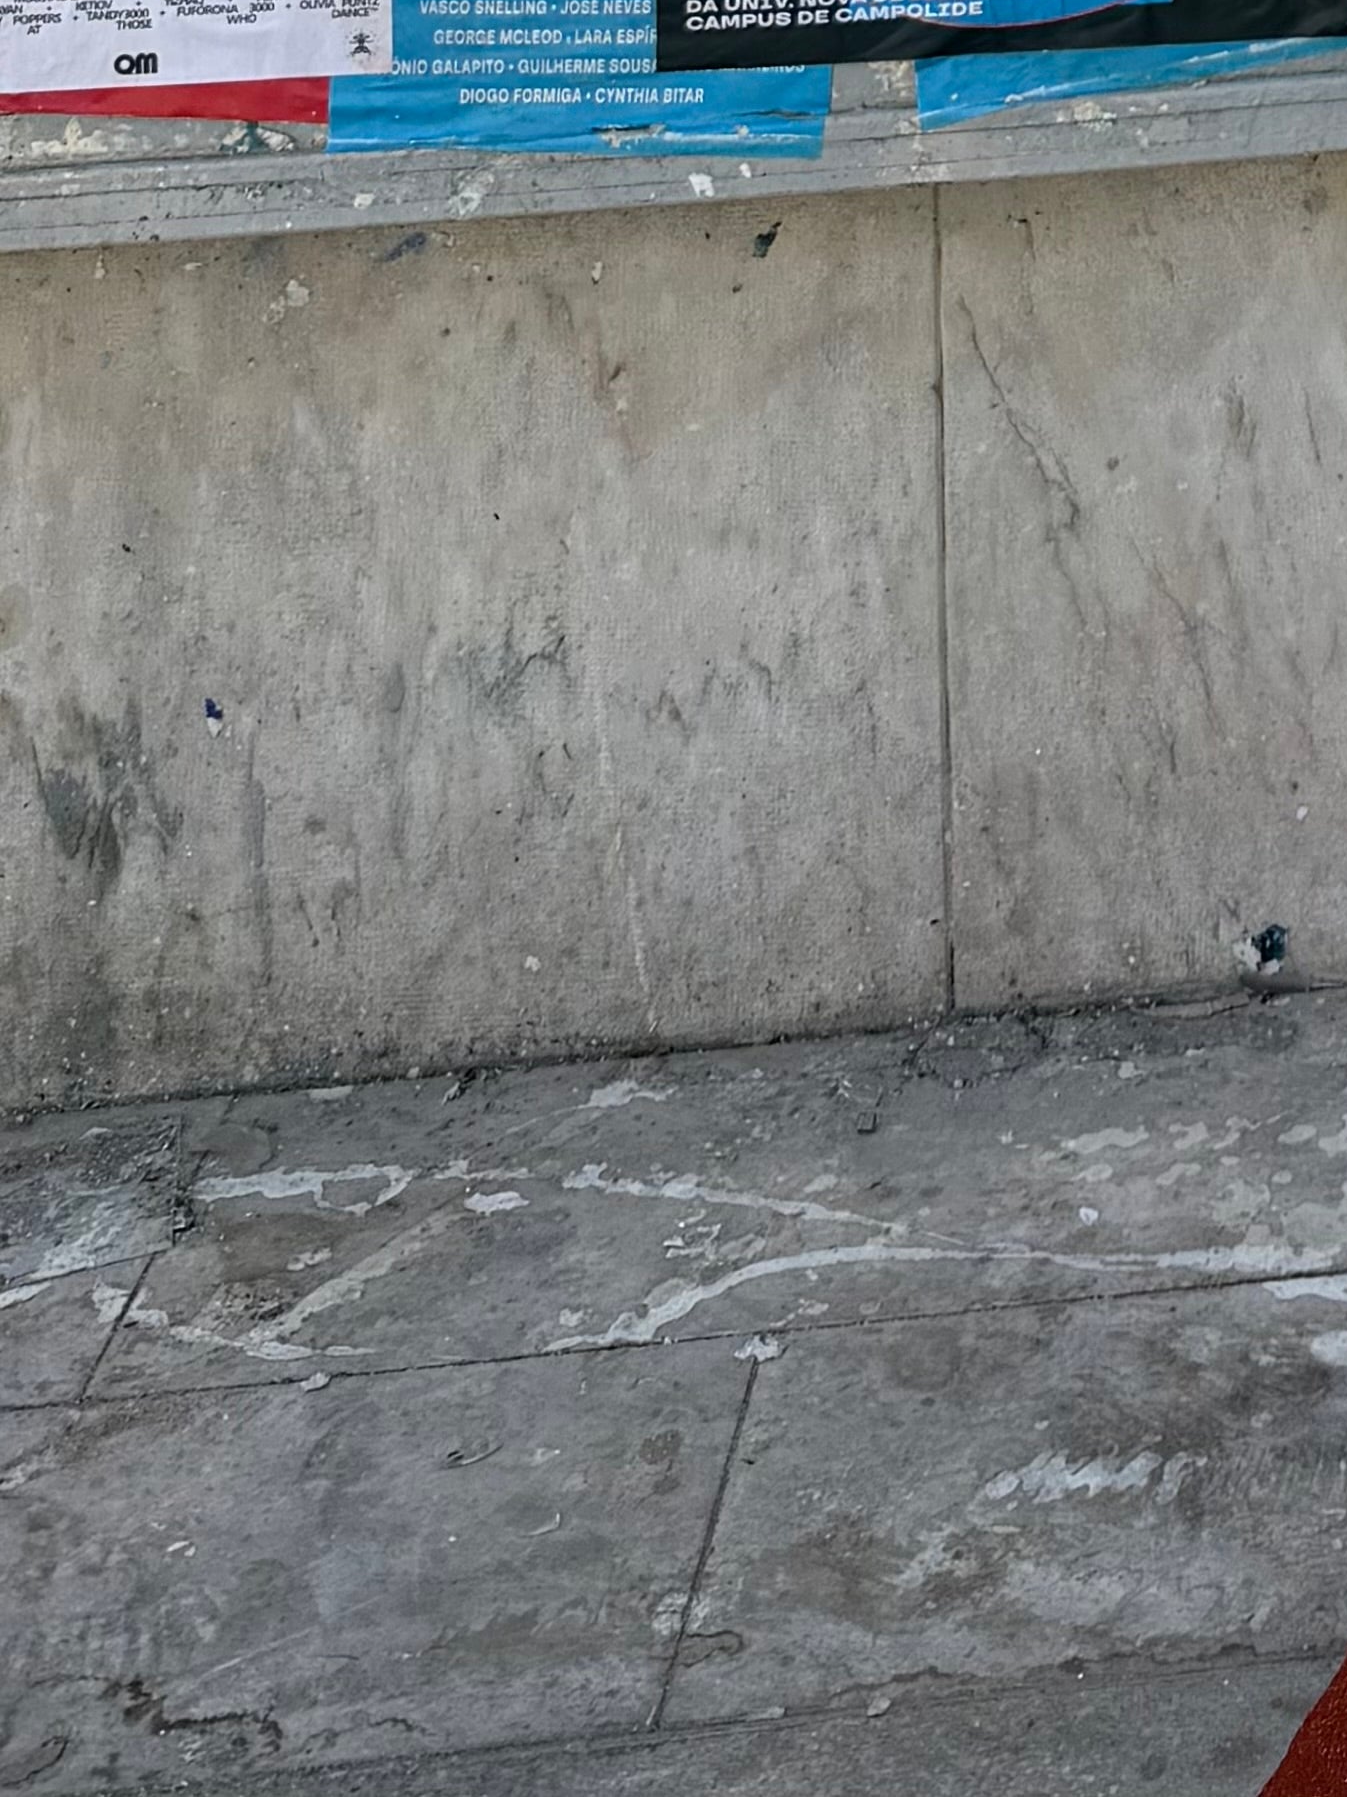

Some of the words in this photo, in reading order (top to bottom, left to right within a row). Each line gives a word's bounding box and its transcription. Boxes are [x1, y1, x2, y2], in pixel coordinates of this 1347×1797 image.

[420, 0, 472, 16] VASCO
[475, 0, 547, 15] SNELLING
[603, 0, 652, 15] NEVES
[434, 29, 496, 46] GEORGE
[500, 29, 563, 45] MCLEOD
[459, 88, 509, 104] DIOGO
[513, 88, 582, 104] FORMIGA
[595, 87, 659, 105] CYNTHIA
[662, 87, 705, 103] BITAR
